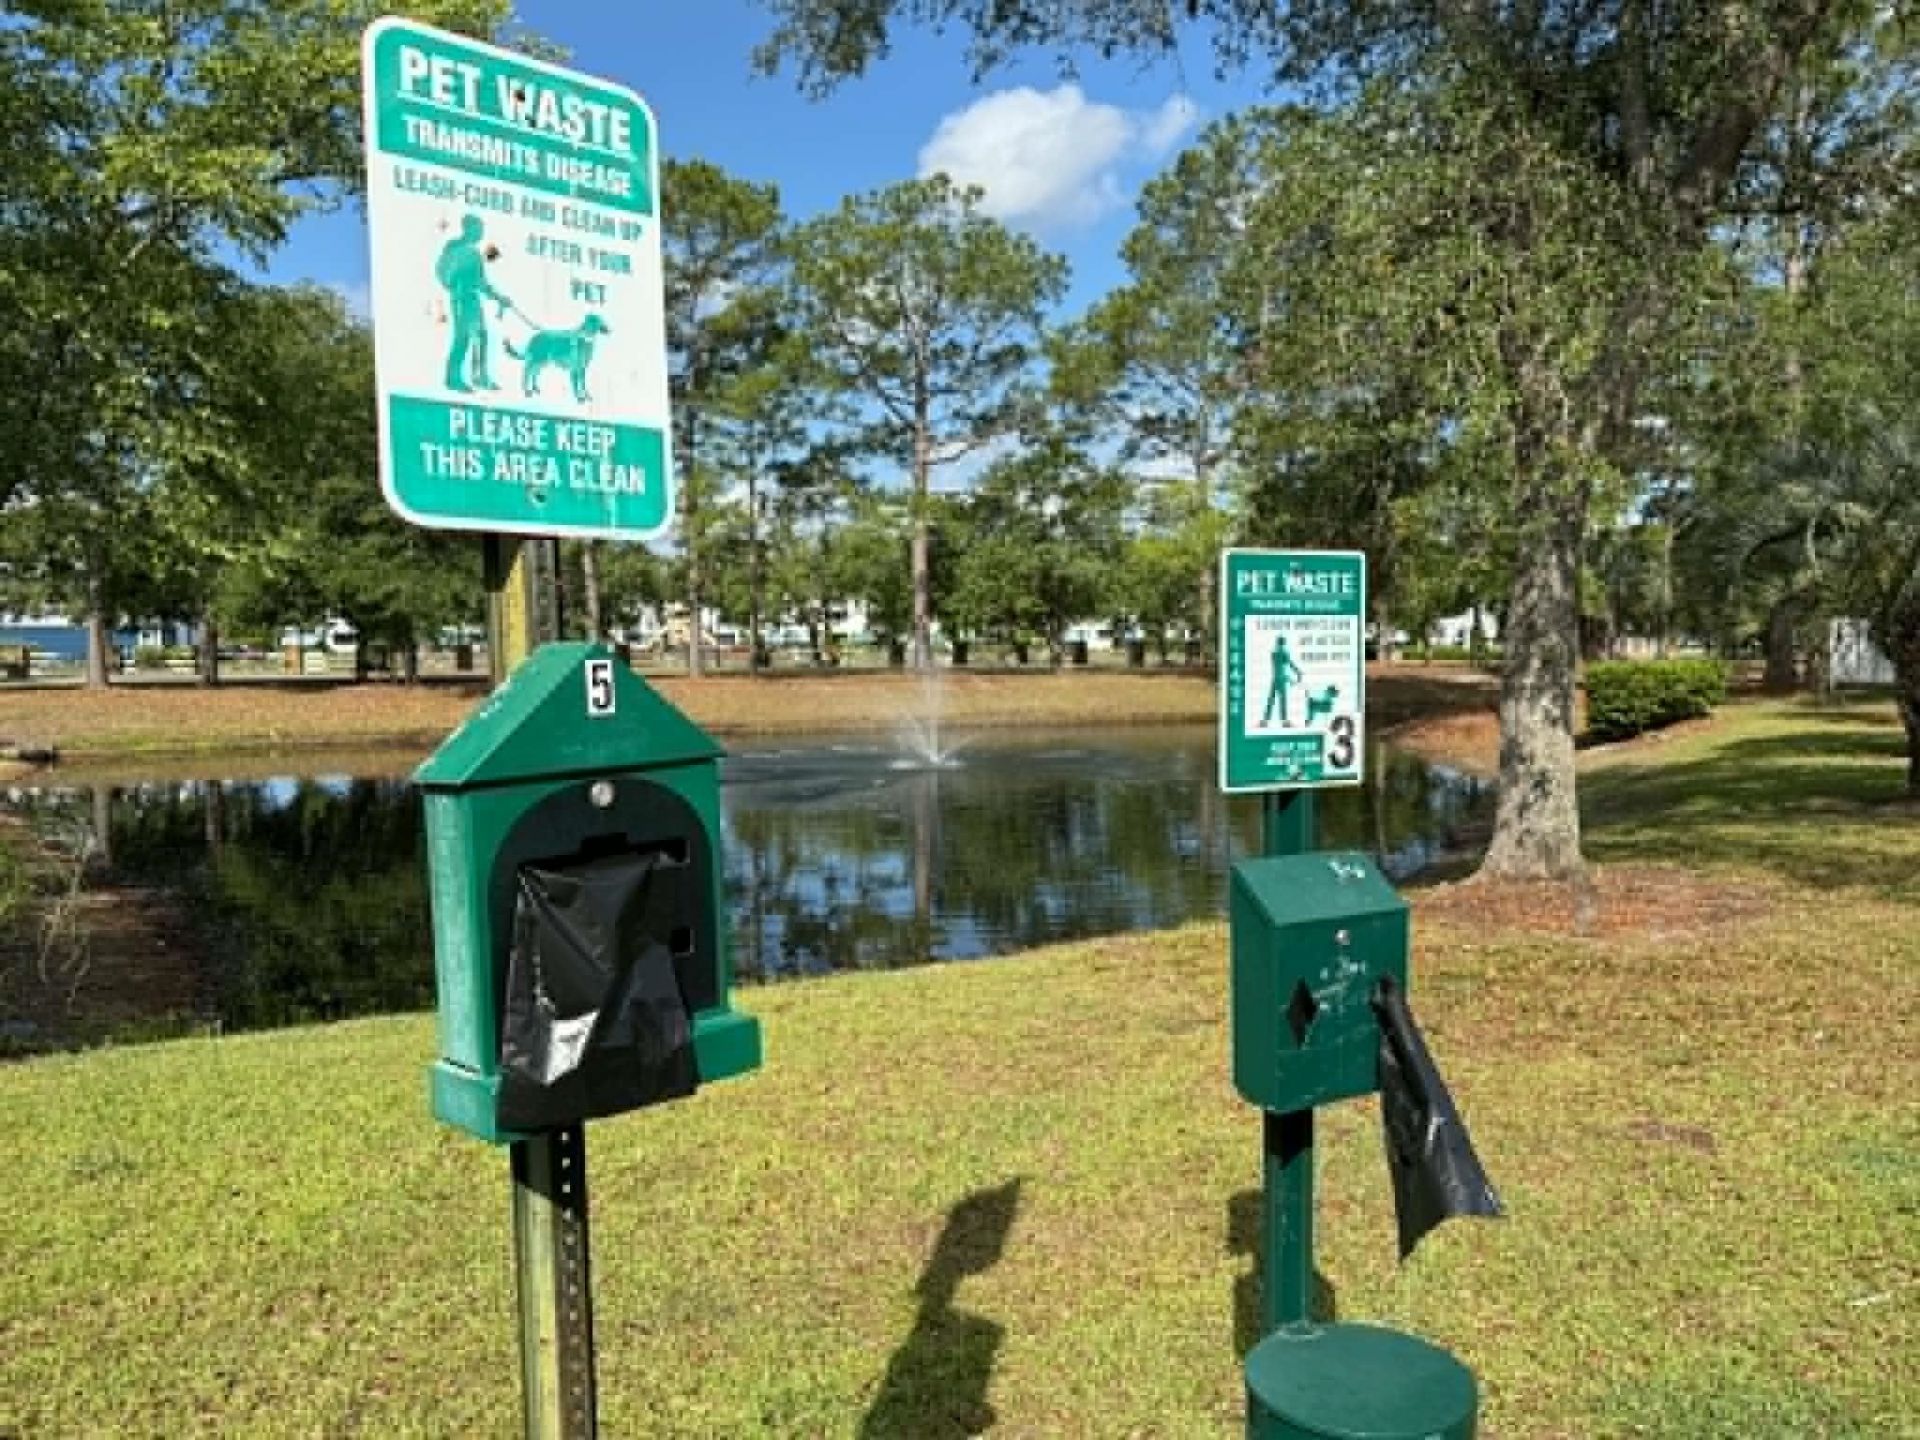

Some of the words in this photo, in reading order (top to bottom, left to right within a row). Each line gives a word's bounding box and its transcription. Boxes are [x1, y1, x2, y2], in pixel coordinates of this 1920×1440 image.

[398, 45, 481, 113] PET
[496, 74, 631, 151] WASTE
[403, 114, 540, 173] TRANSMITS
[549, 152, 632, 199] DISEASE
[525, 232, 582, 263] AFTER
[588, 246, 632, 274] YOUR
[570, 278, 607, 305] PET
[449, 407, 549, 450] PLEASE
[554, 420, 616, 458] KEEP
[418, 441, 485, 481] THIS
[493, 449, 562, 489] AREA
[568, 457, 646, 496] CLEAN
[1237, 569, 1276, 593] PET
[1282, 570, 1358, 594] WASTE
[592, 663, 612, 710] 5
[1328, 715, 1355, 769] 3
